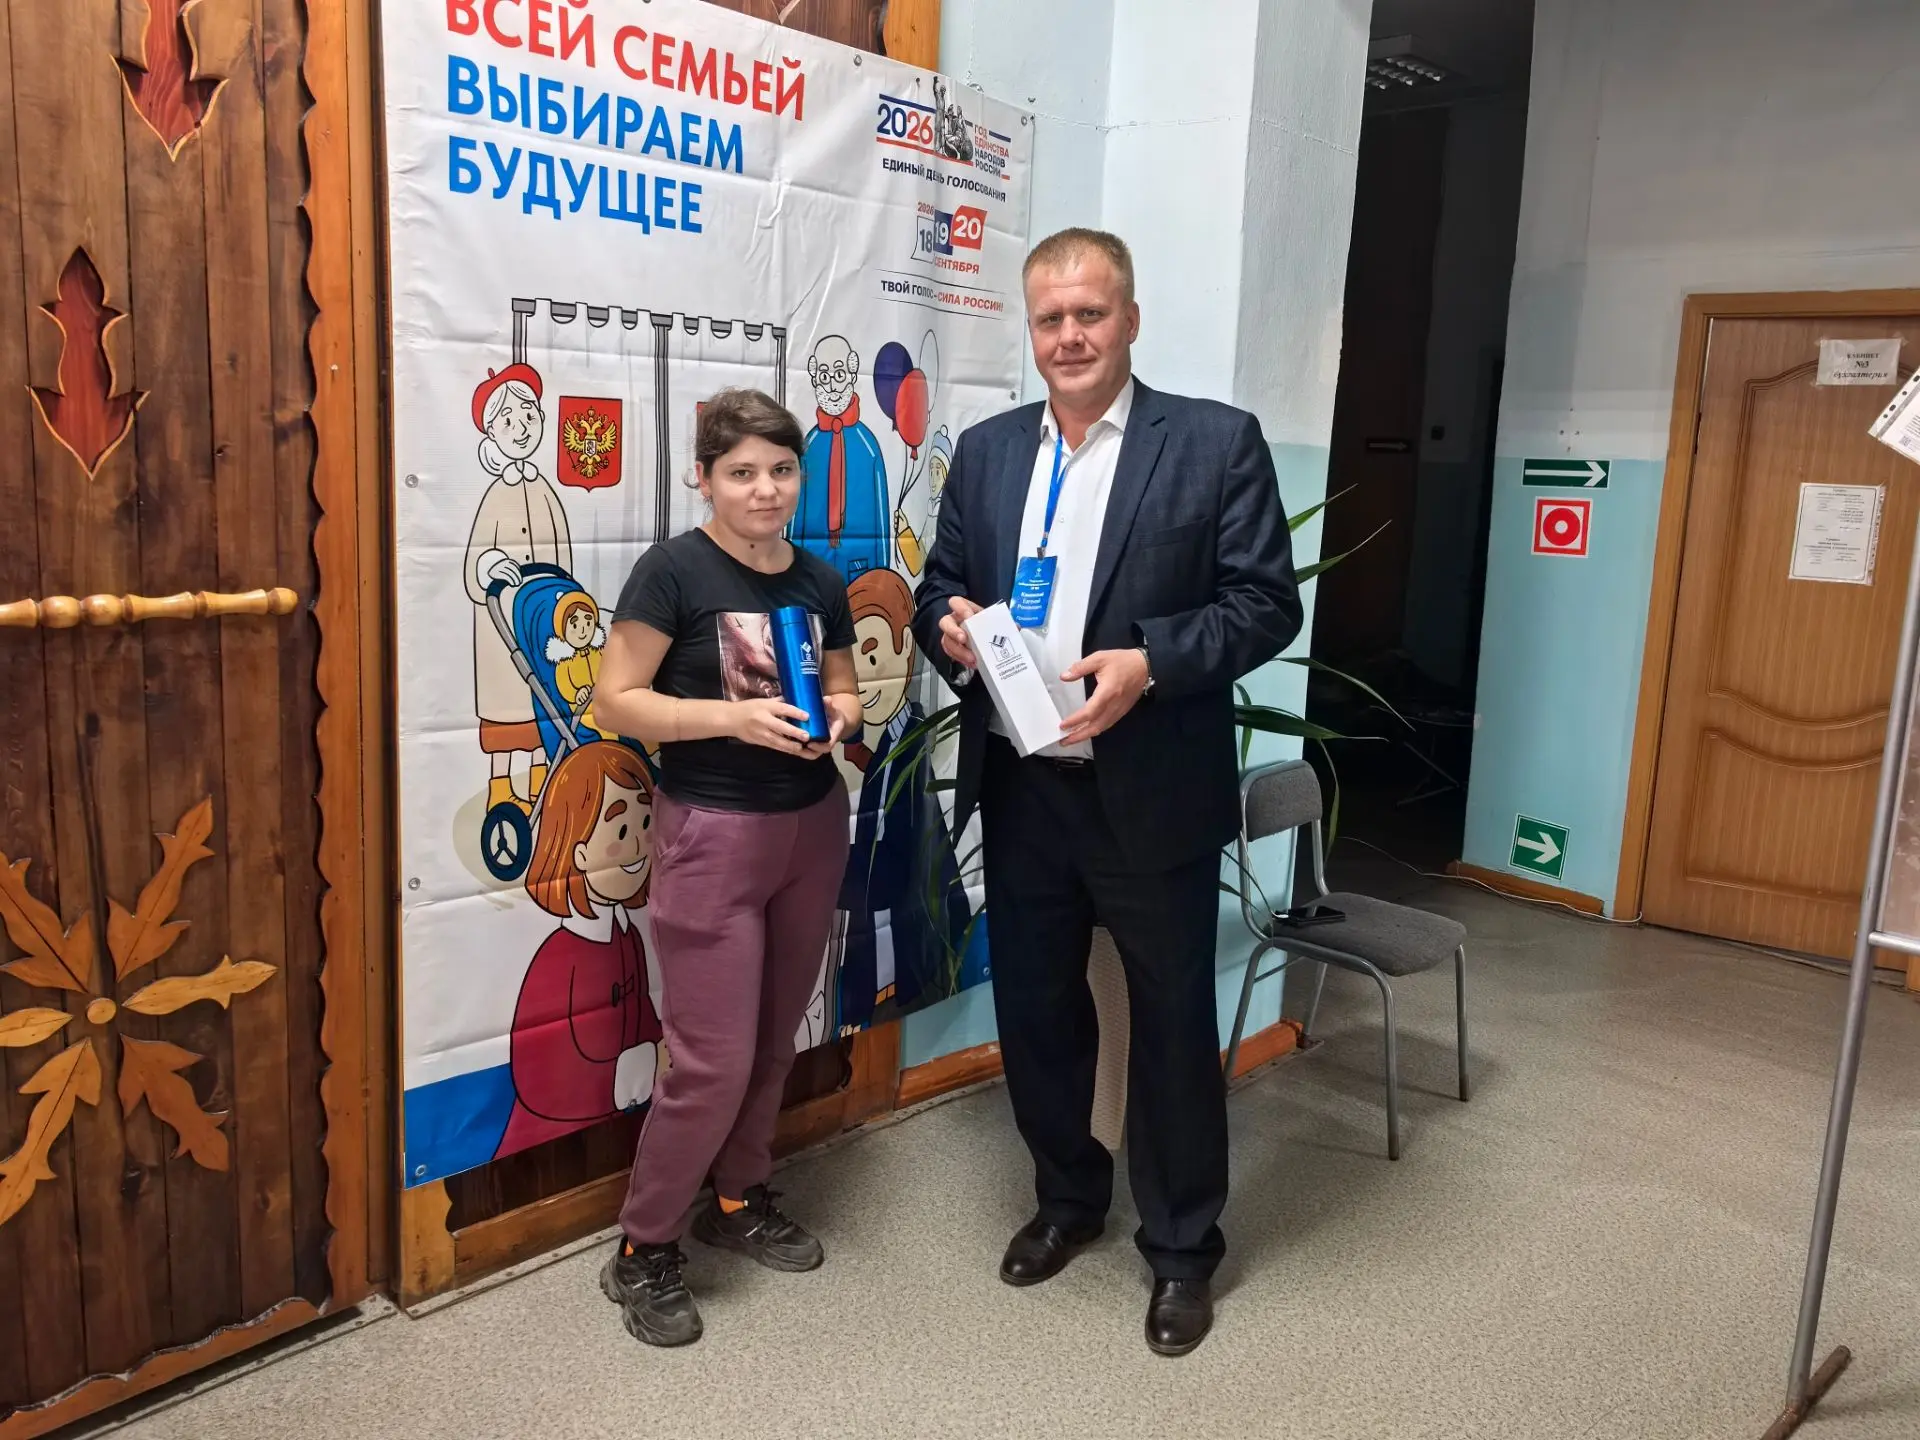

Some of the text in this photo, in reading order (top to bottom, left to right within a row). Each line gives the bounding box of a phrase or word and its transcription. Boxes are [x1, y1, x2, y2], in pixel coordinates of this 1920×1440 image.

[446, 0, 806, 121] ВСЕЙ СЕМЬЕЙ
[448, 54, 744, 174] ВЫБИРАЕМ
[877, 103, 933, 145] 2026
[974, 124, 988, 138] ГОД
[974, 135, 1010, 157] ЕДИНСТВА
[975, 149, 1006, 168] НАРОДОВ
[975, 160, 1001, 177] РОССИИ
[448, 135, 703, 236] БУДУЩЕЕ
[882, 157, 1006, 203] ЕДИНЫЙ ДЕНЬ ГОЛОСОВАНИЯ
[917, 202, 934, 216] 2026
[919, 215, 981, 253] 18 19 20
[934, 257, 980, 275] СЕНТЯБРЯ
[881, 280, 910, 294] ТВОЙ
[963, 295, 1004, 313] РОССИИ!
